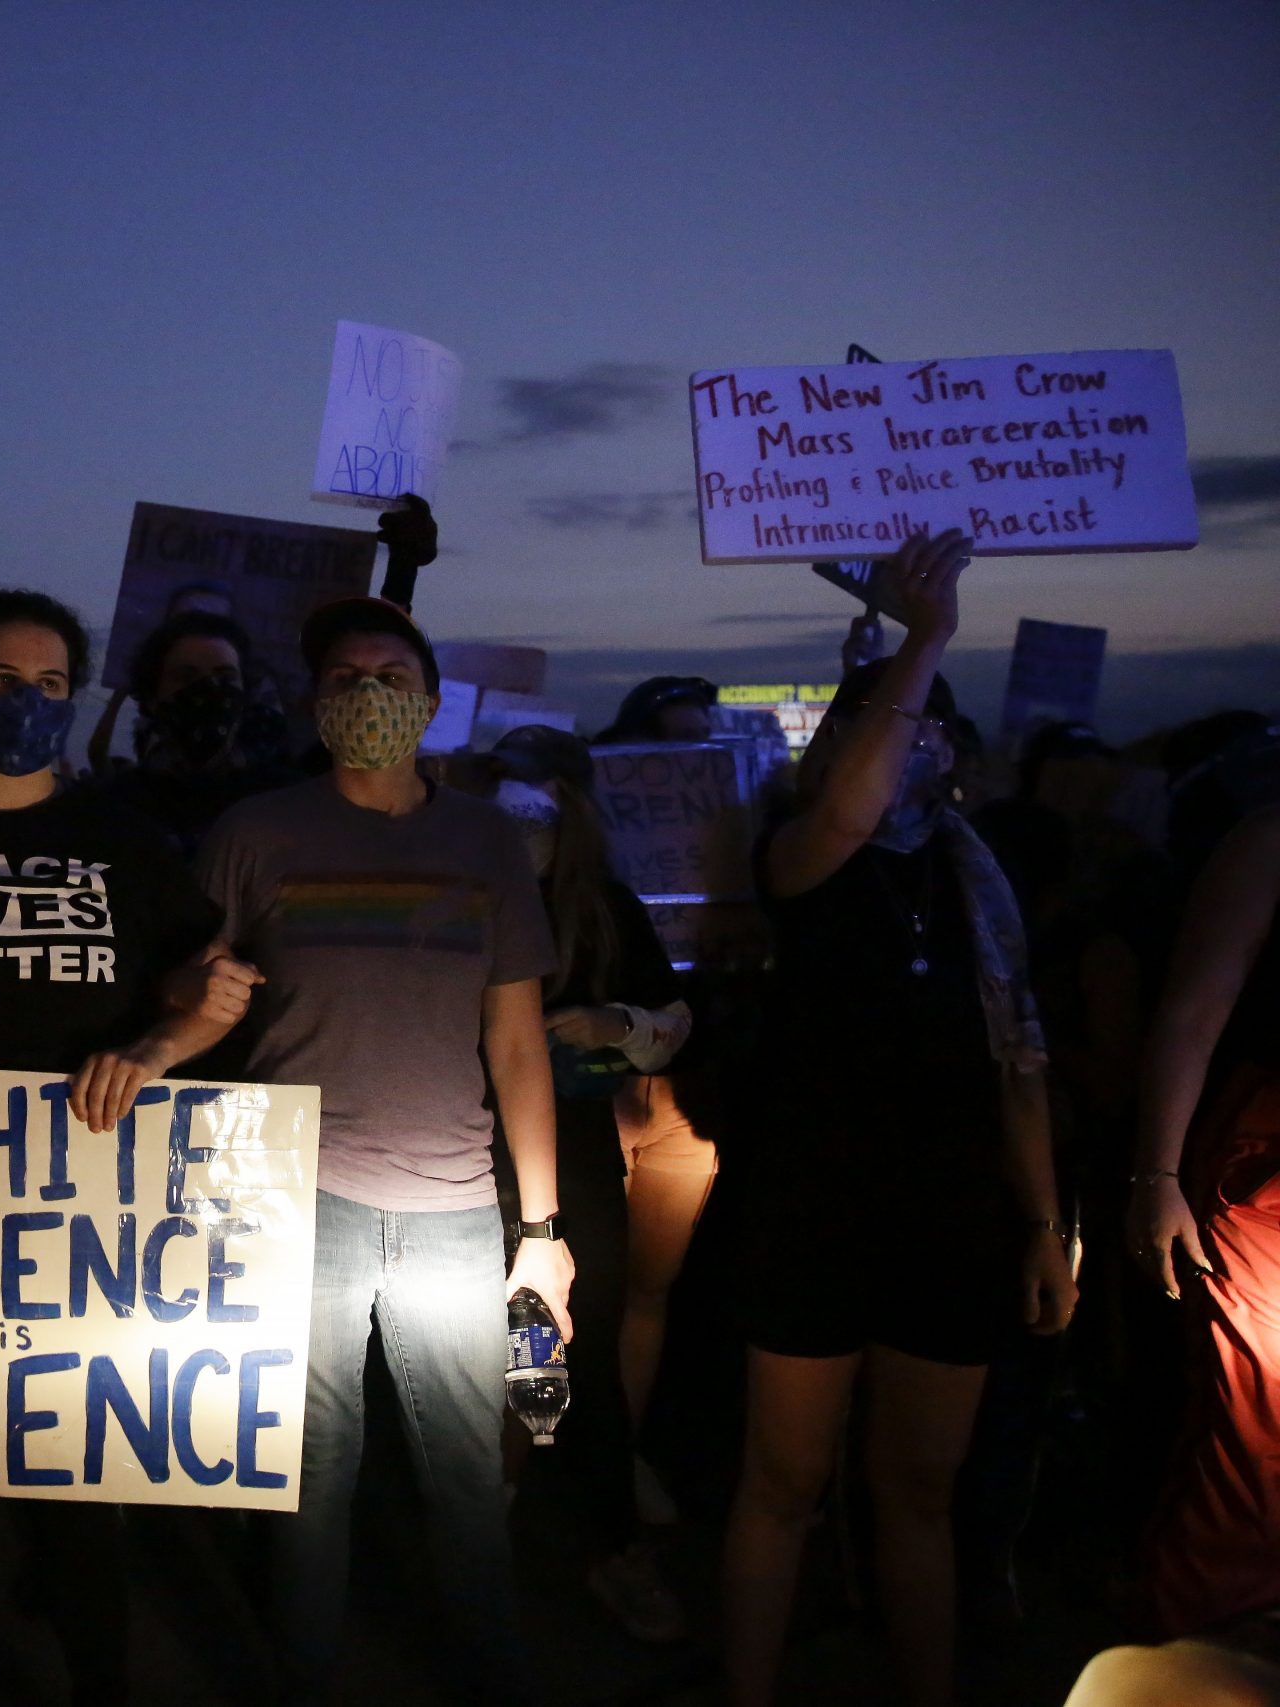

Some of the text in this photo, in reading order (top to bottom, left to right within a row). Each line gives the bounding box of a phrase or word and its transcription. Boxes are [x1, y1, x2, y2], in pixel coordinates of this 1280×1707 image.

[694, 361, 1106, 418] The New Jim Crow
[758, 406, 1149, 460] Mass Incarceration
[705, 467, 830, 509] Profiling
[875, 462, 958, 497] Police
[969, 448, 1125, 490] Brutality
[753, 496, 1098, 548] Intrinsically Racist
[0, 1321, 33, 1351] is
